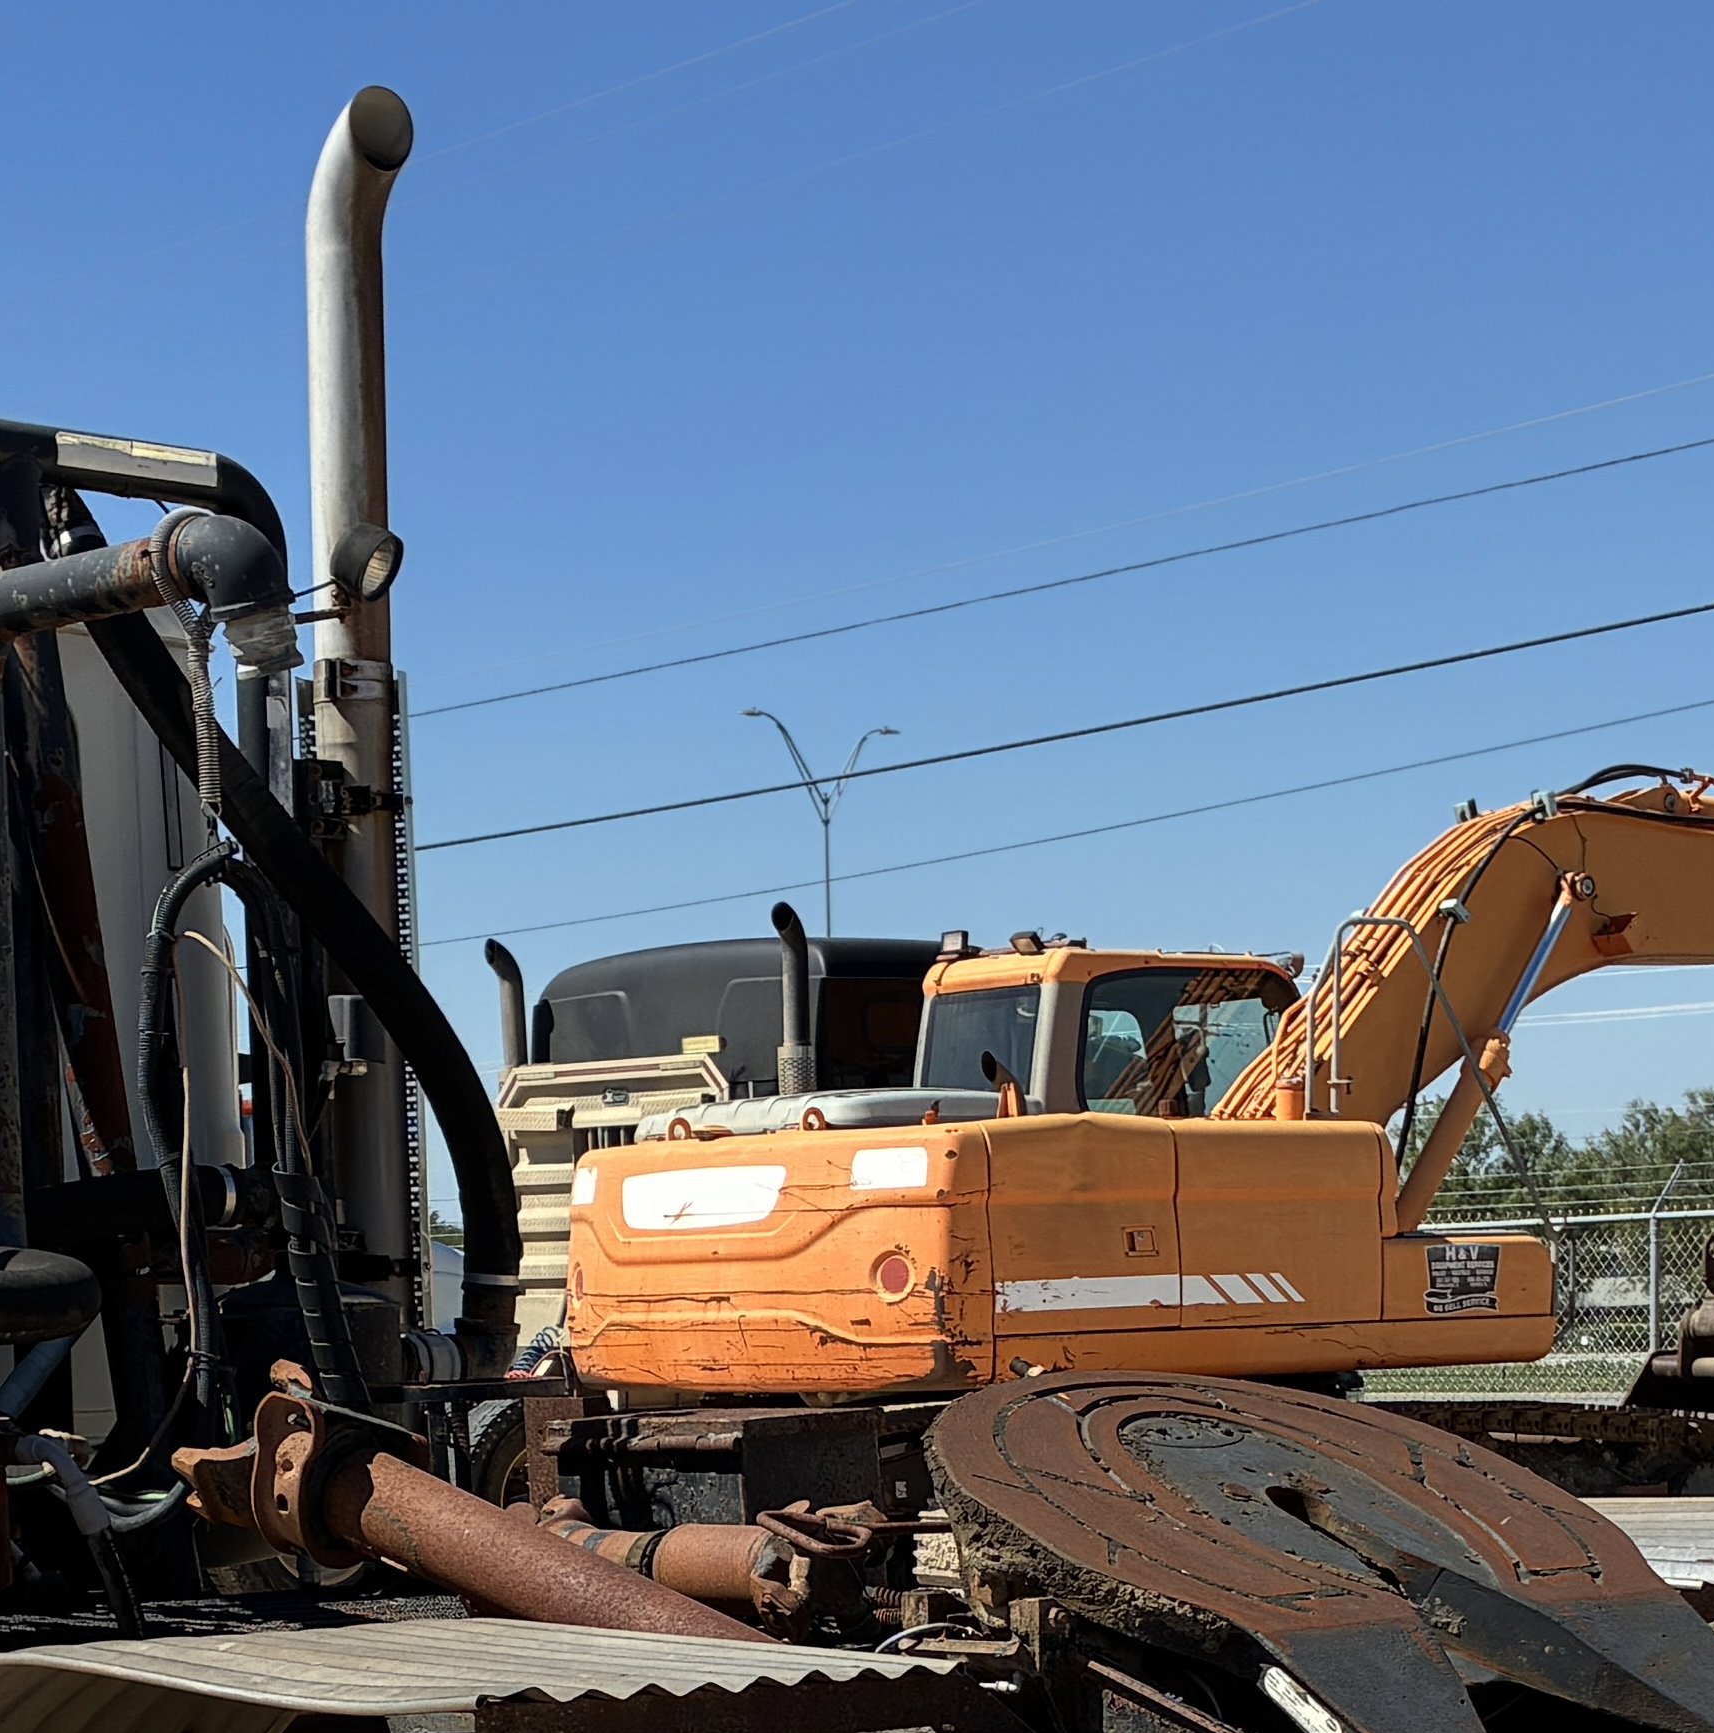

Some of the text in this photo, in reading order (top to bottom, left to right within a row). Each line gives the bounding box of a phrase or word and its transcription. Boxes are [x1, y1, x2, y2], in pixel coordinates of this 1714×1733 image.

[1445, 1246, 1479, 1261] H & V
